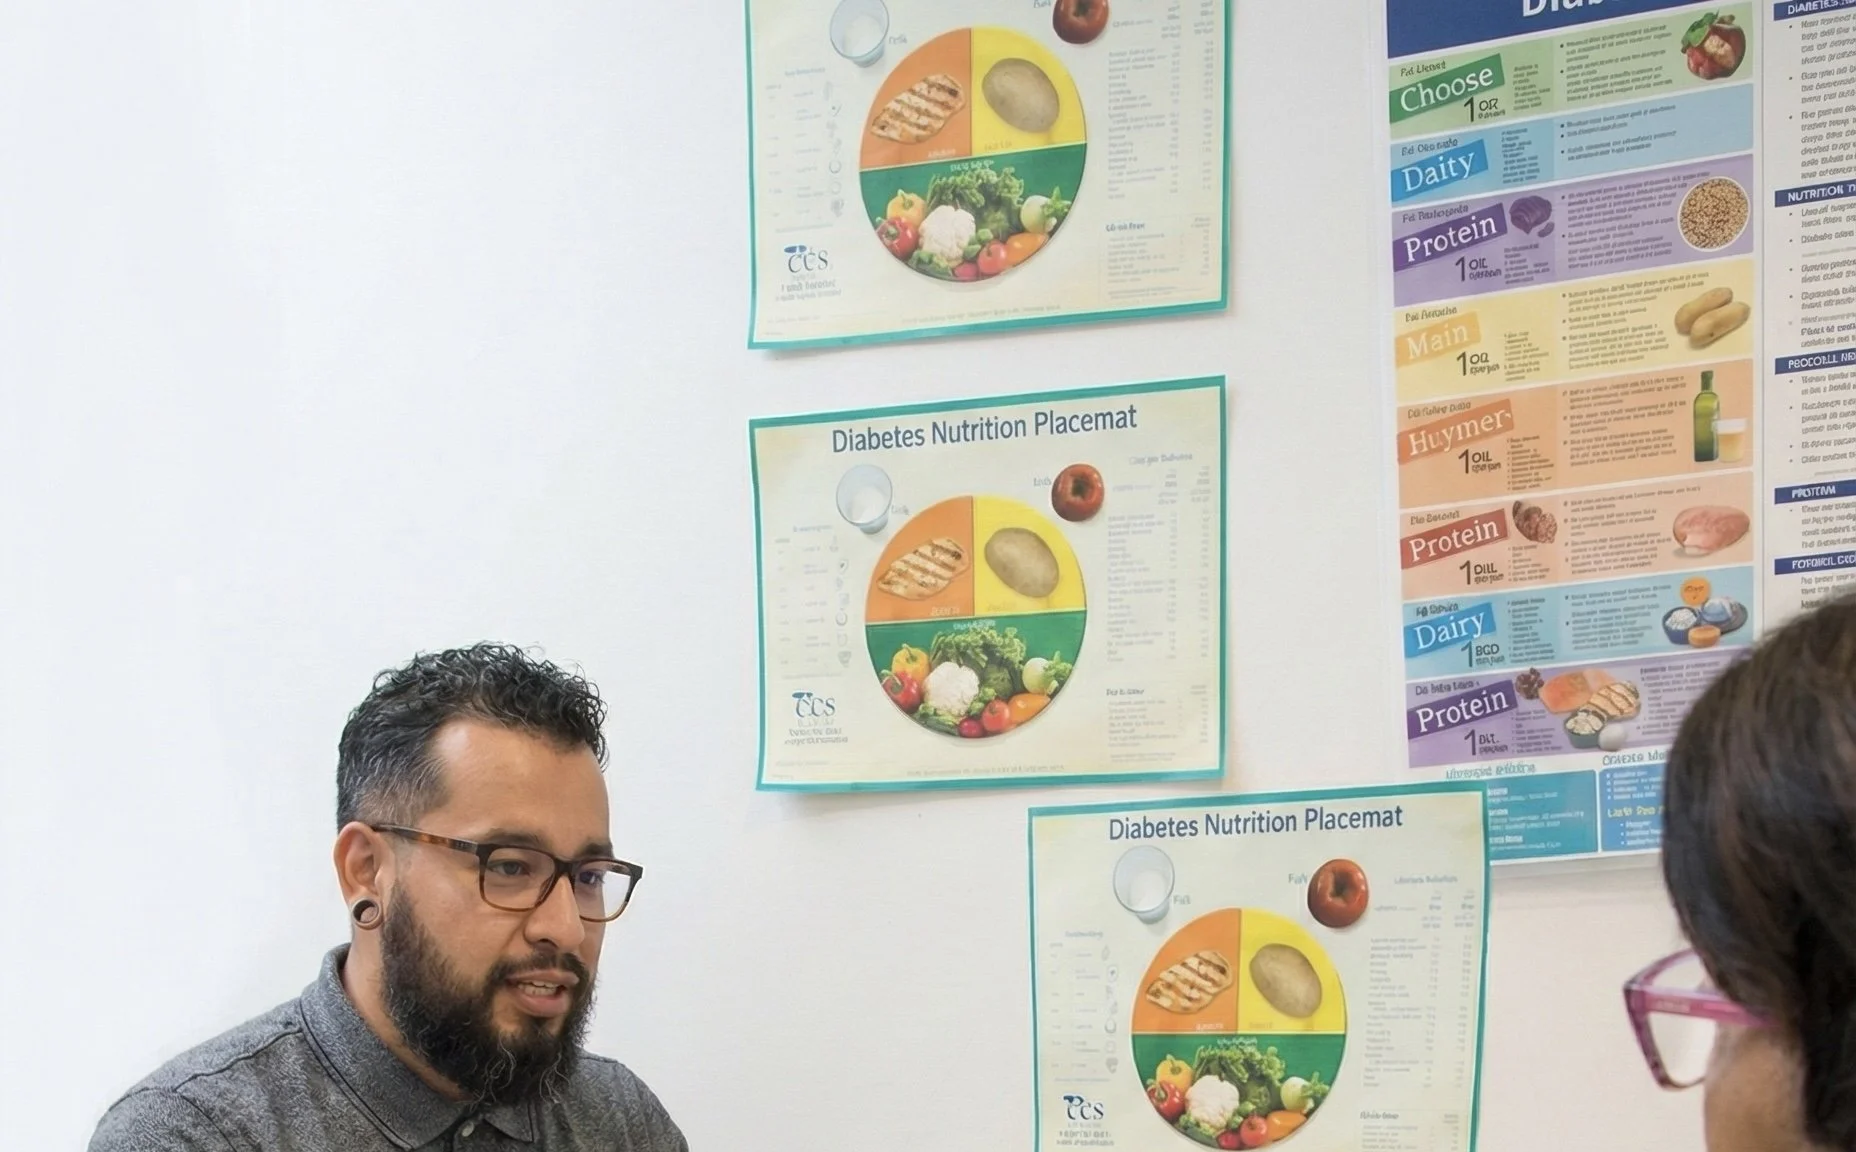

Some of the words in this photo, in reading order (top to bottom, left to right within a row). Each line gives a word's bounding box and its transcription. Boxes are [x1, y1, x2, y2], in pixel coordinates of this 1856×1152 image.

[1400, 68, 1494, 112] Choose
[1404, 215, 1498, 263] Protein
[1407, 322, 1468, 360] Main
[832, 426, 925, 453] Diabetes
[932, 416, 1027, 445] Nutrition
[1034, 404, 1138, 436] Placemat
[1409, 519, 1500, 562] Protein
[1414, 612, 1485, 650] Dairy
[1416, 689, 1509, 734] Protein
[1109, 816, 1199, 841] Diabetes
[1205, 810, 1297, 836] Nutrition
[1305, 805, 1403, 831] Placemat
